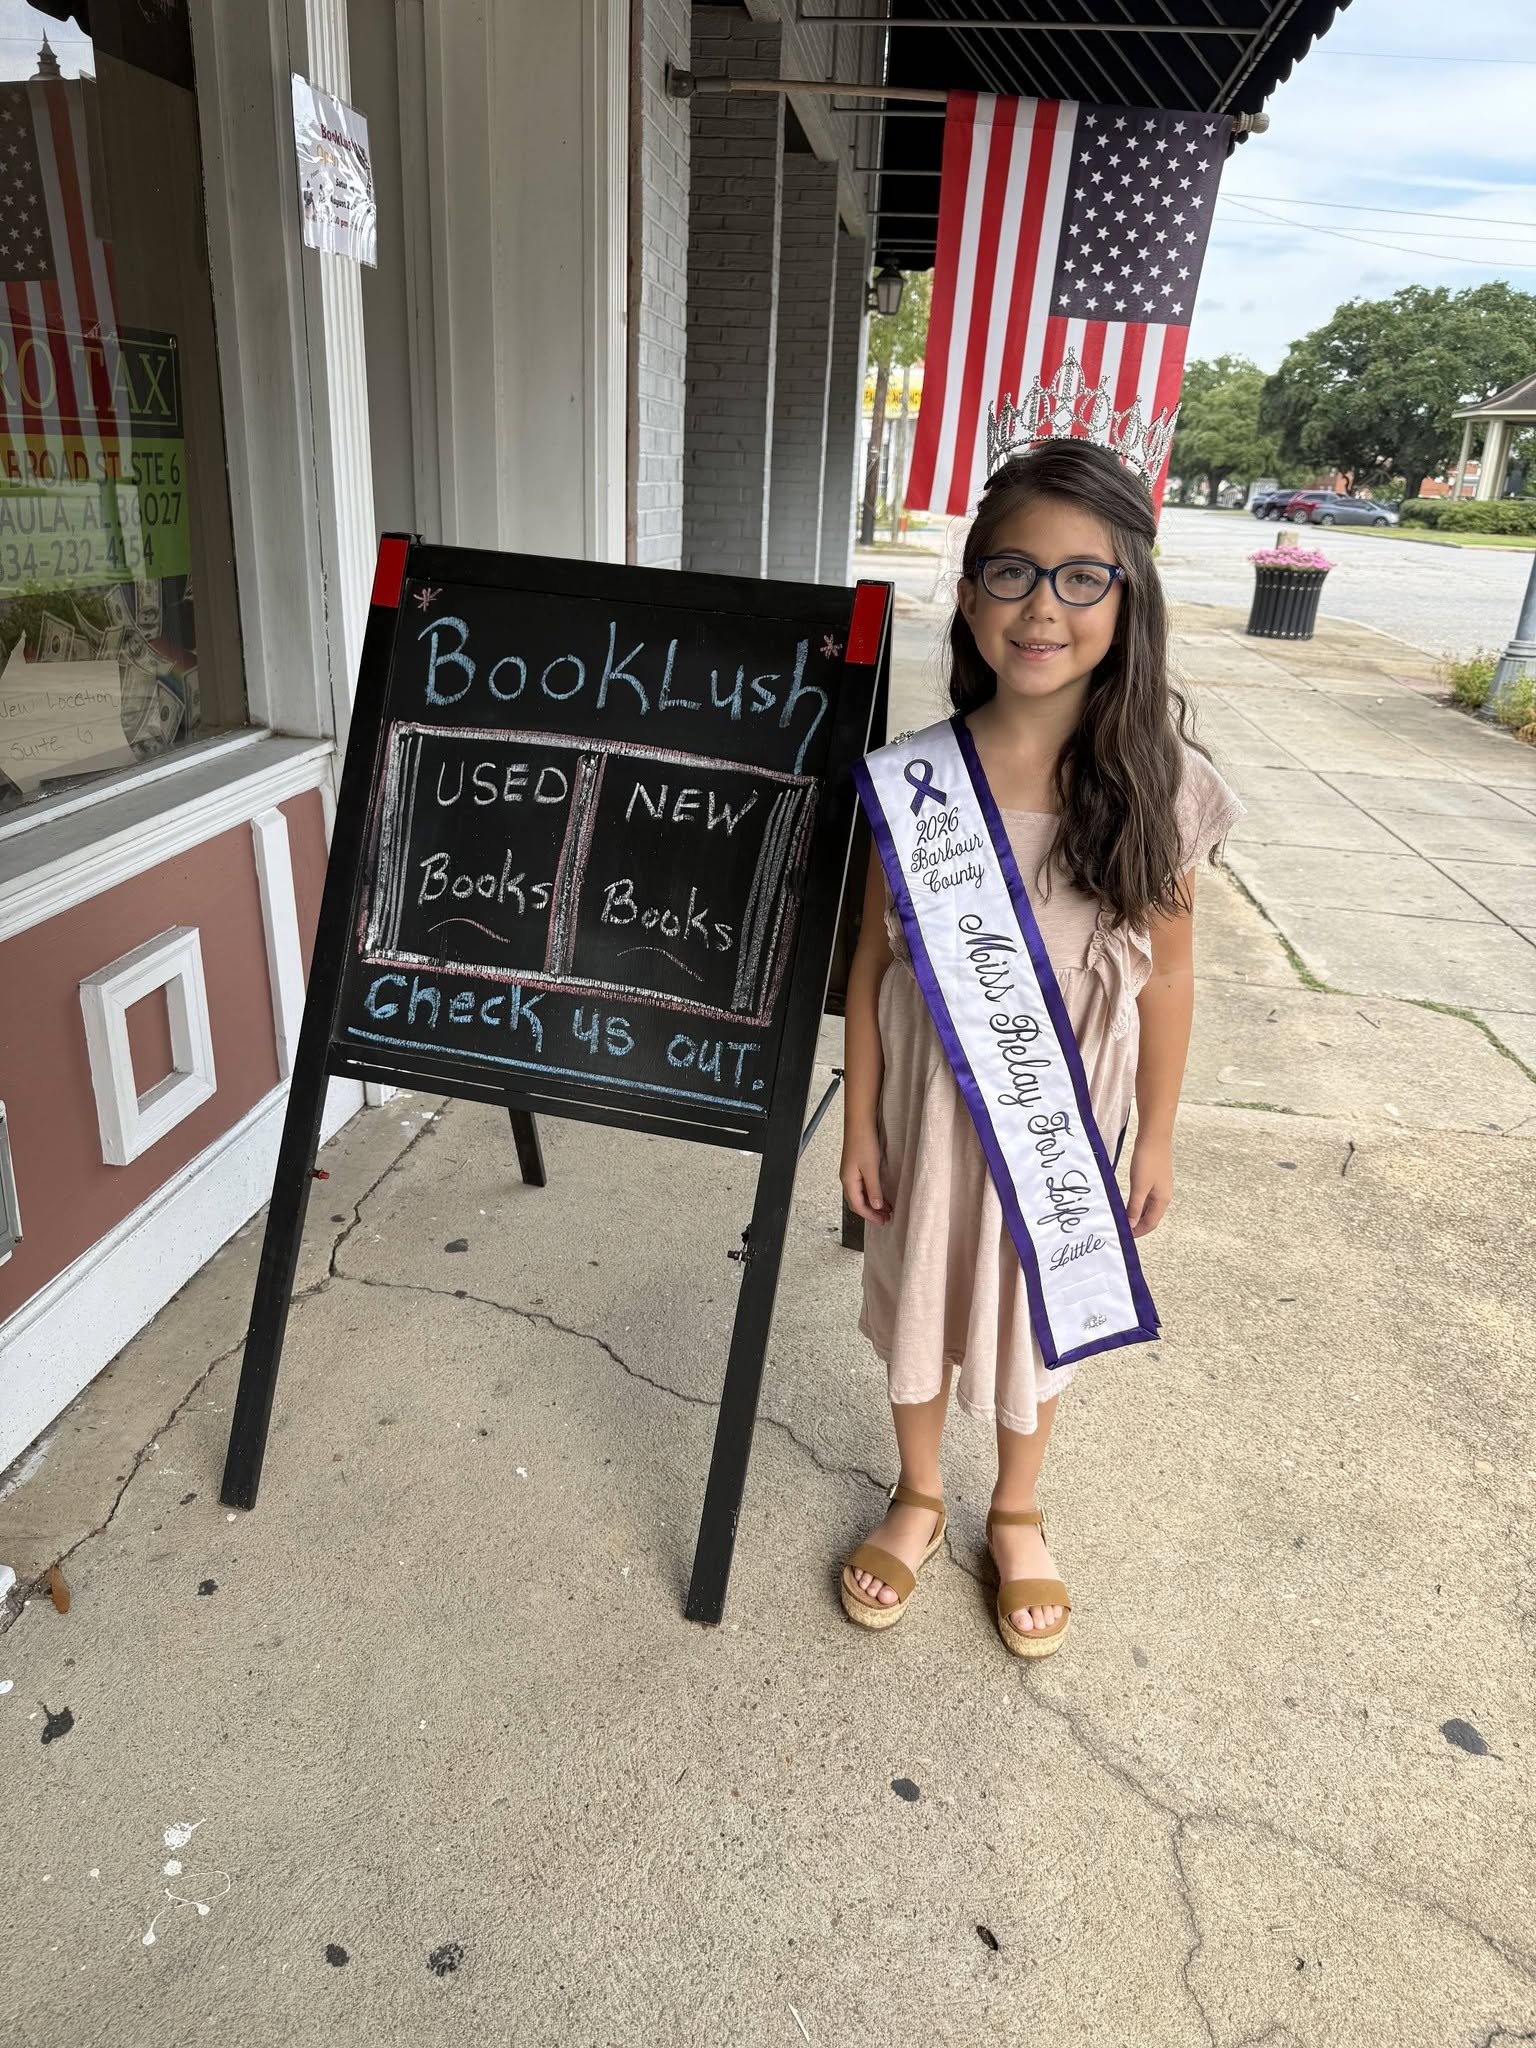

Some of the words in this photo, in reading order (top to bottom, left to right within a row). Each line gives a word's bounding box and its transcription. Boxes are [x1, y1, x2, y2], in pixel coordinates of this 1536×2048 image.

[72, 344, 171, 416] TAX
[7, 450, 90, 489] BROAD
[95, 450, 120, 487] ST
[131, 452, 165, 486] STE
[170, 453, 180, 486] 6
[82, 494, 112, 531] AL
[116, 492, 182, 528] 36027
[0, 534, 154, 583] 34-232-4154
[11, 736, 65, 761] Suite
[436, 762, 568, 806] USED
[625, 782, 759, 836] NEW
[916, 806, 959, 846] 2026
[910, 833, 984, 873] Barbour
[923, 861, 984, 895] County
[418, 849, 553, 915] Books
[601, 878, 733, 952] Books
[958, 913, 1018, 1003] Miss
[363, 973, 547, 1053] Check
[572, 1006, 636, 1058] us
[989, 1013, 1051, 1108] Relay
[1027, 1111, 1075, 1169] For
[1037, 1170, 1092, 1234] Life
[1049, 1233, 1106, 1272] Little
